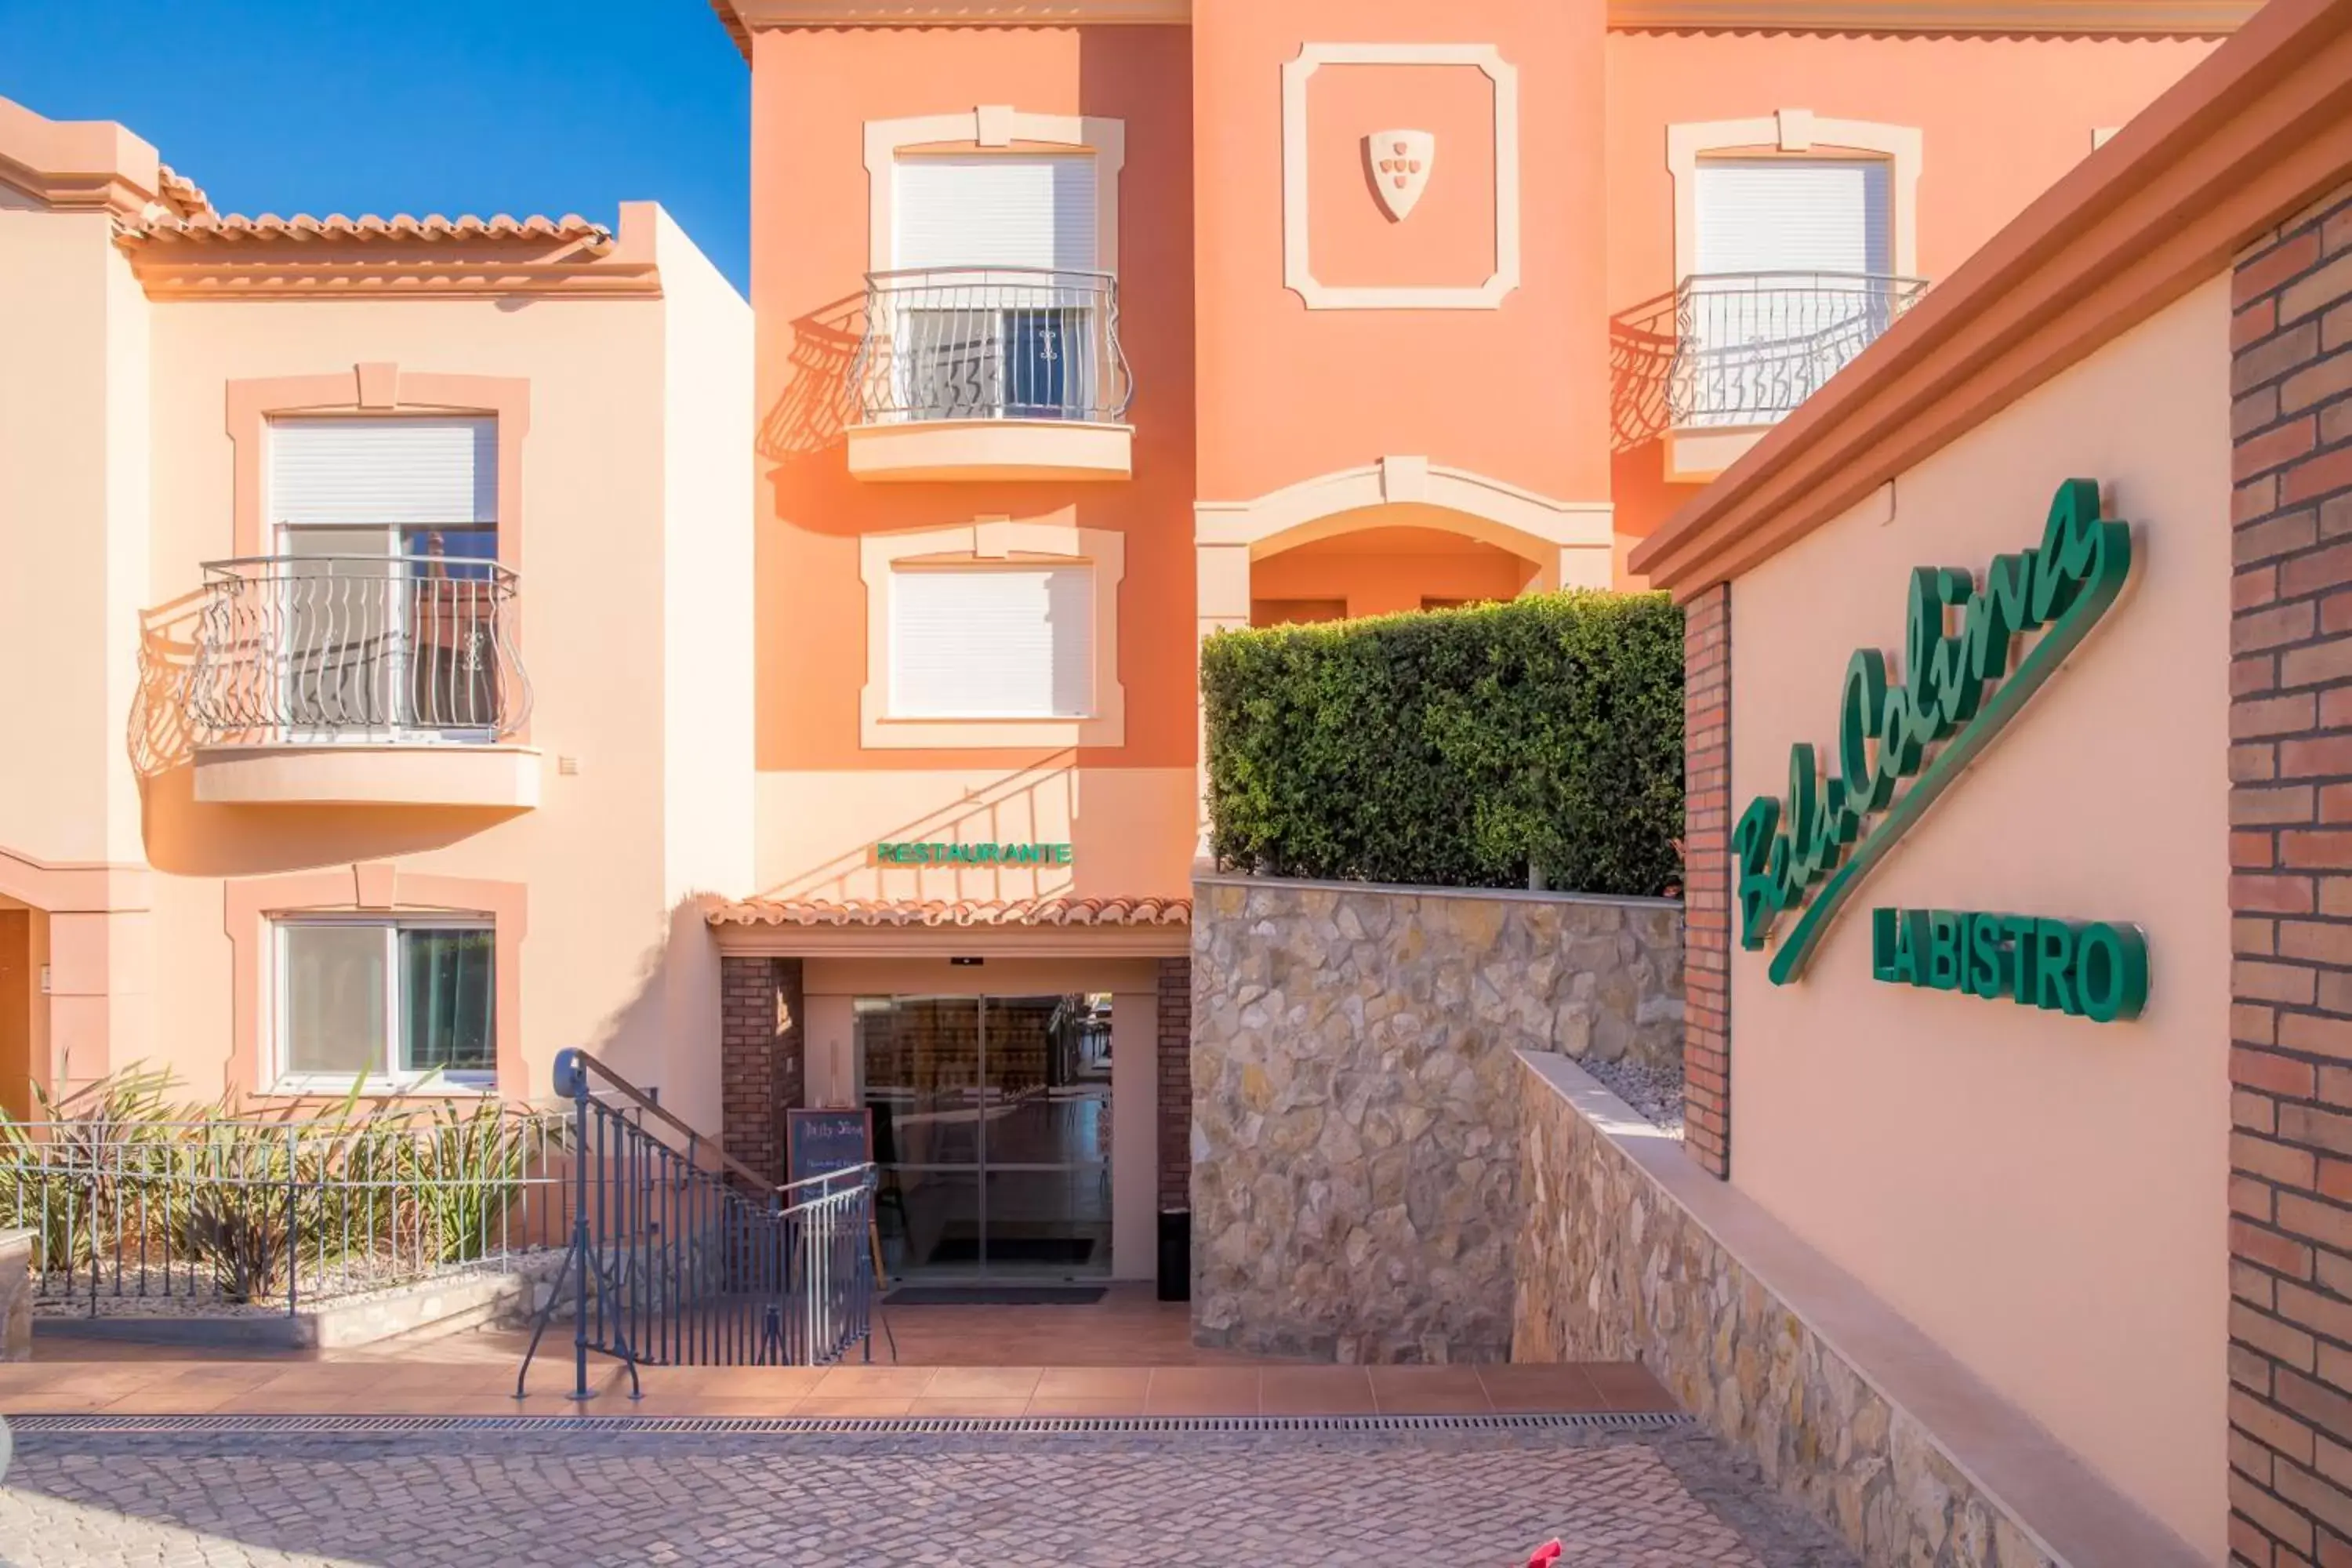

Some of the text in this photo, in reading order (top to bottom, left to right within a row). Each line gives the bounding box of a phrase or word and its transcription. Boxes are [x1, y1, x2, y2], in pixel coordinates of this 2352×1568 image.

[877, 842, 1073, 864] RESTAURANTE
[1872, 907, 2150, 1023] LA BISTRO
